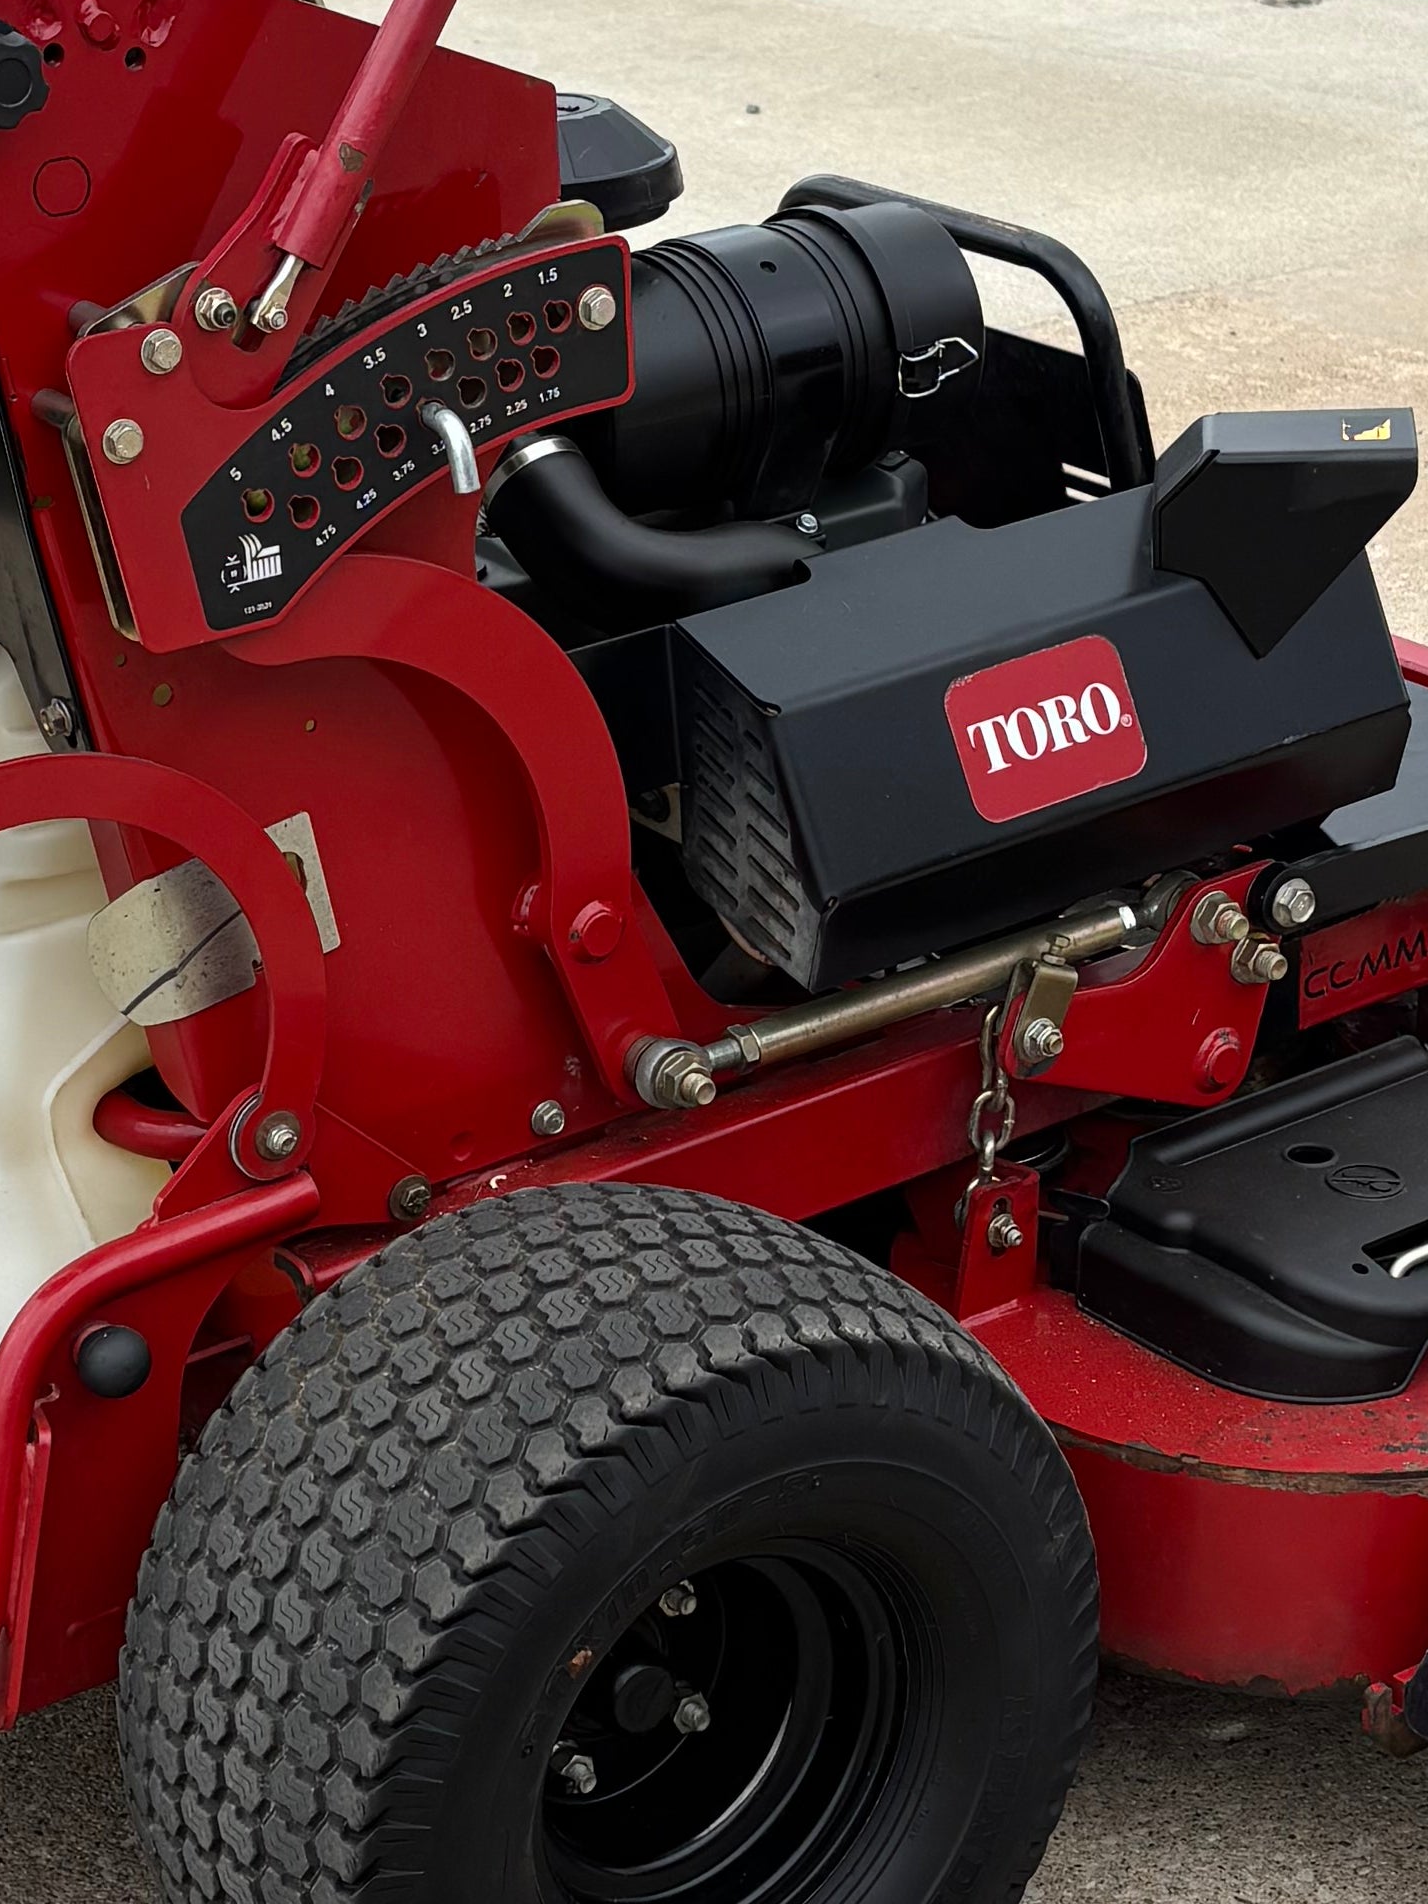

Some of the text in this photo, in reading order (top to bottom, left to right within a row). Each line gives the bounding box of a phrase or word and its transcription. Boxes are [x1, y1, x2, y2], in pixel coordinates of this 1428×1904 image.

[537, 267, 559, 286] 1.5
[502, 283, 513, 298] 2
[450, 298, 473, 321] 2.5
[416, 322, 428, 338] 3
[362, 346, 387, 370] 3.5
[324, 383, 335, 397] 4
[538, 386, 561, 403] 1.75
[505, 399, 528, 416] 2.25
[270, 417, 293, 442] 4.5
[468, 413, 492, 434] 2.75
[431, 438, 446, 456] 3.2
[229, 466, 243, 483] 5
[392, 459, 416, 482] 3.75
[355, 487, 378, 510] 4.25
[313, 523, 338, 548] 4.75
